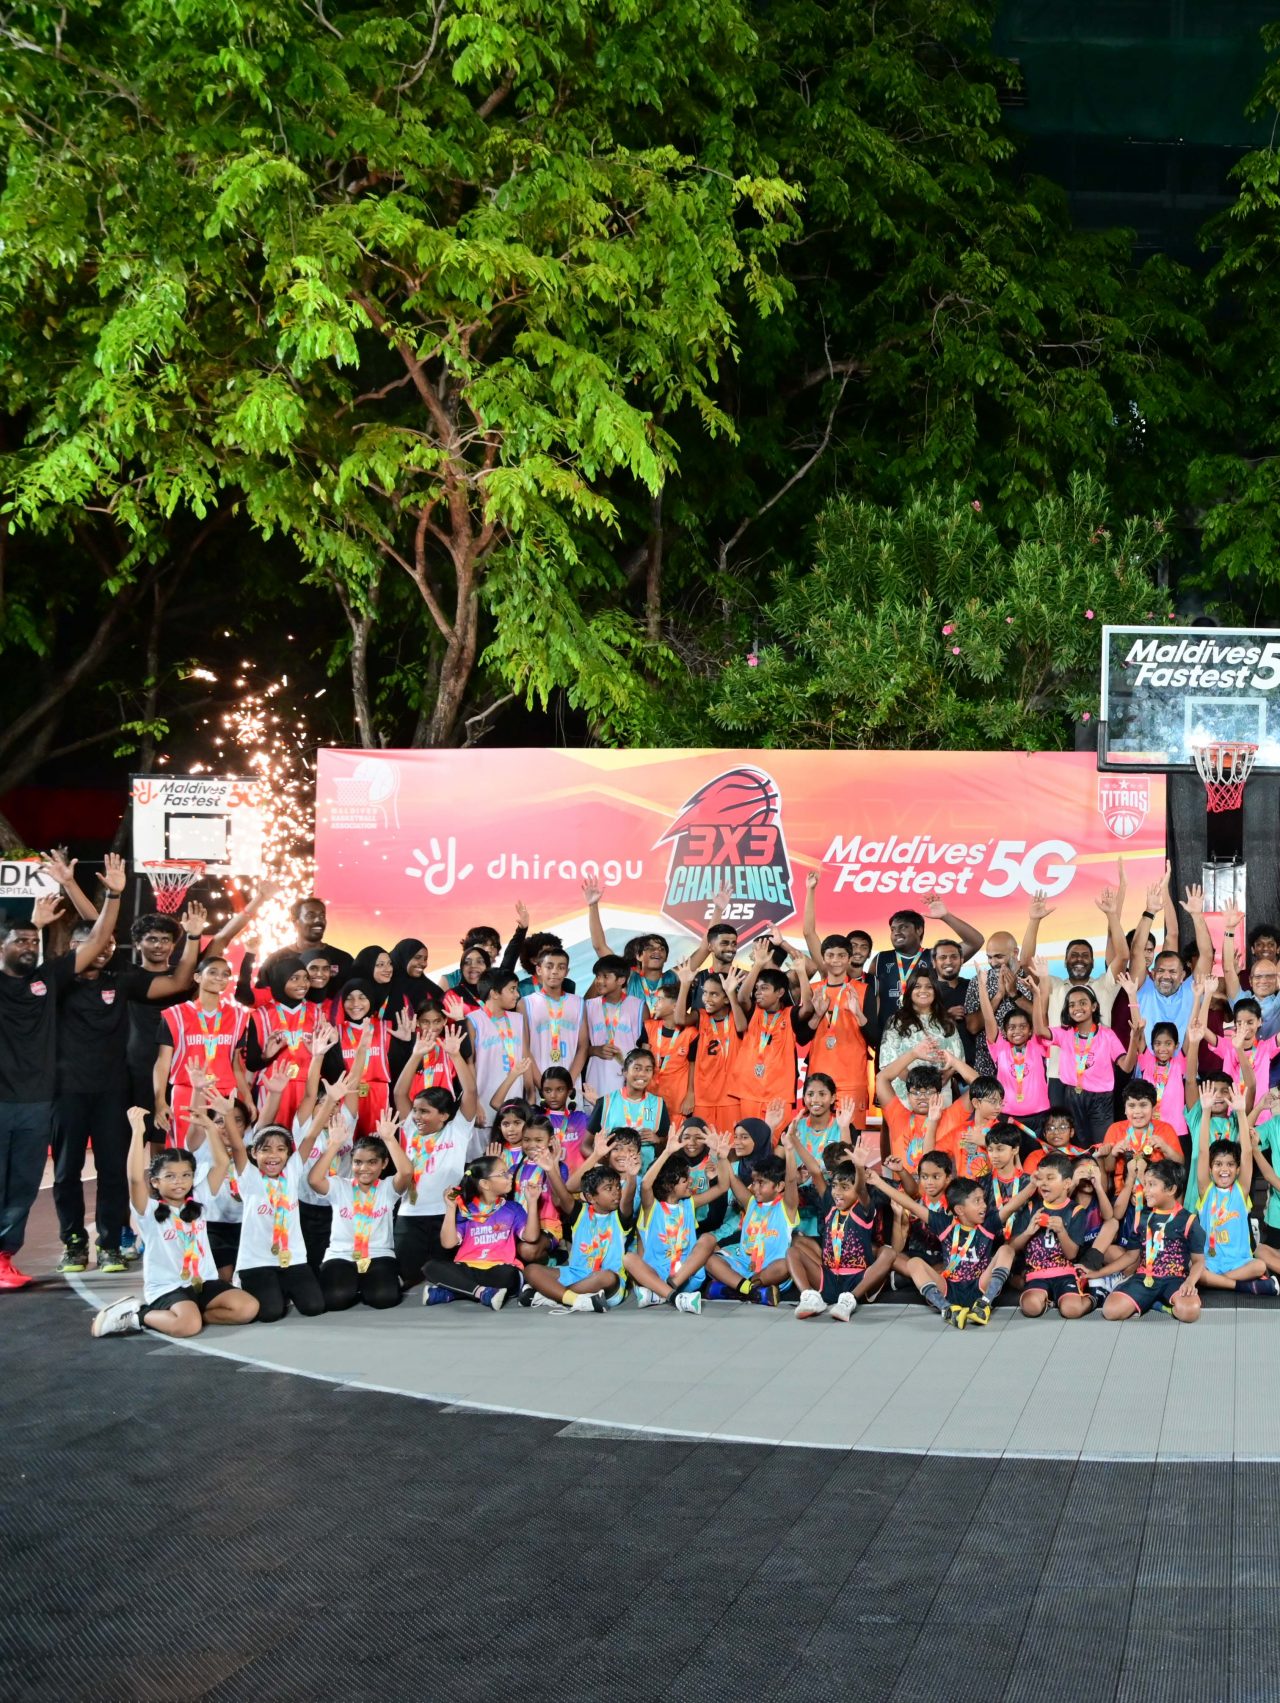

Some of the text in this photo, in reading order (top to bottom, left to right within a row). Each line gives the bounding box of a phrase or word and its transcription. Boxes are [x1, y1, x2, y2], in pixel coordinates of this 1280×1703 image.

[1125, 639, 1262, 664] Maldives
[1134, 662, 1249, 688] Fastest
[163, 794, 221, 807] Fastest
[331, 807, 378, 815] MALDIVES
[1101, 790, 1148, 811] TITANS
[683, 826, 778, 866] 3X3
[487, 853, 643, 887] dhiraagu
[833, 863, 973, 895] Fastest
[979, 839, 1078, 899] 5G
